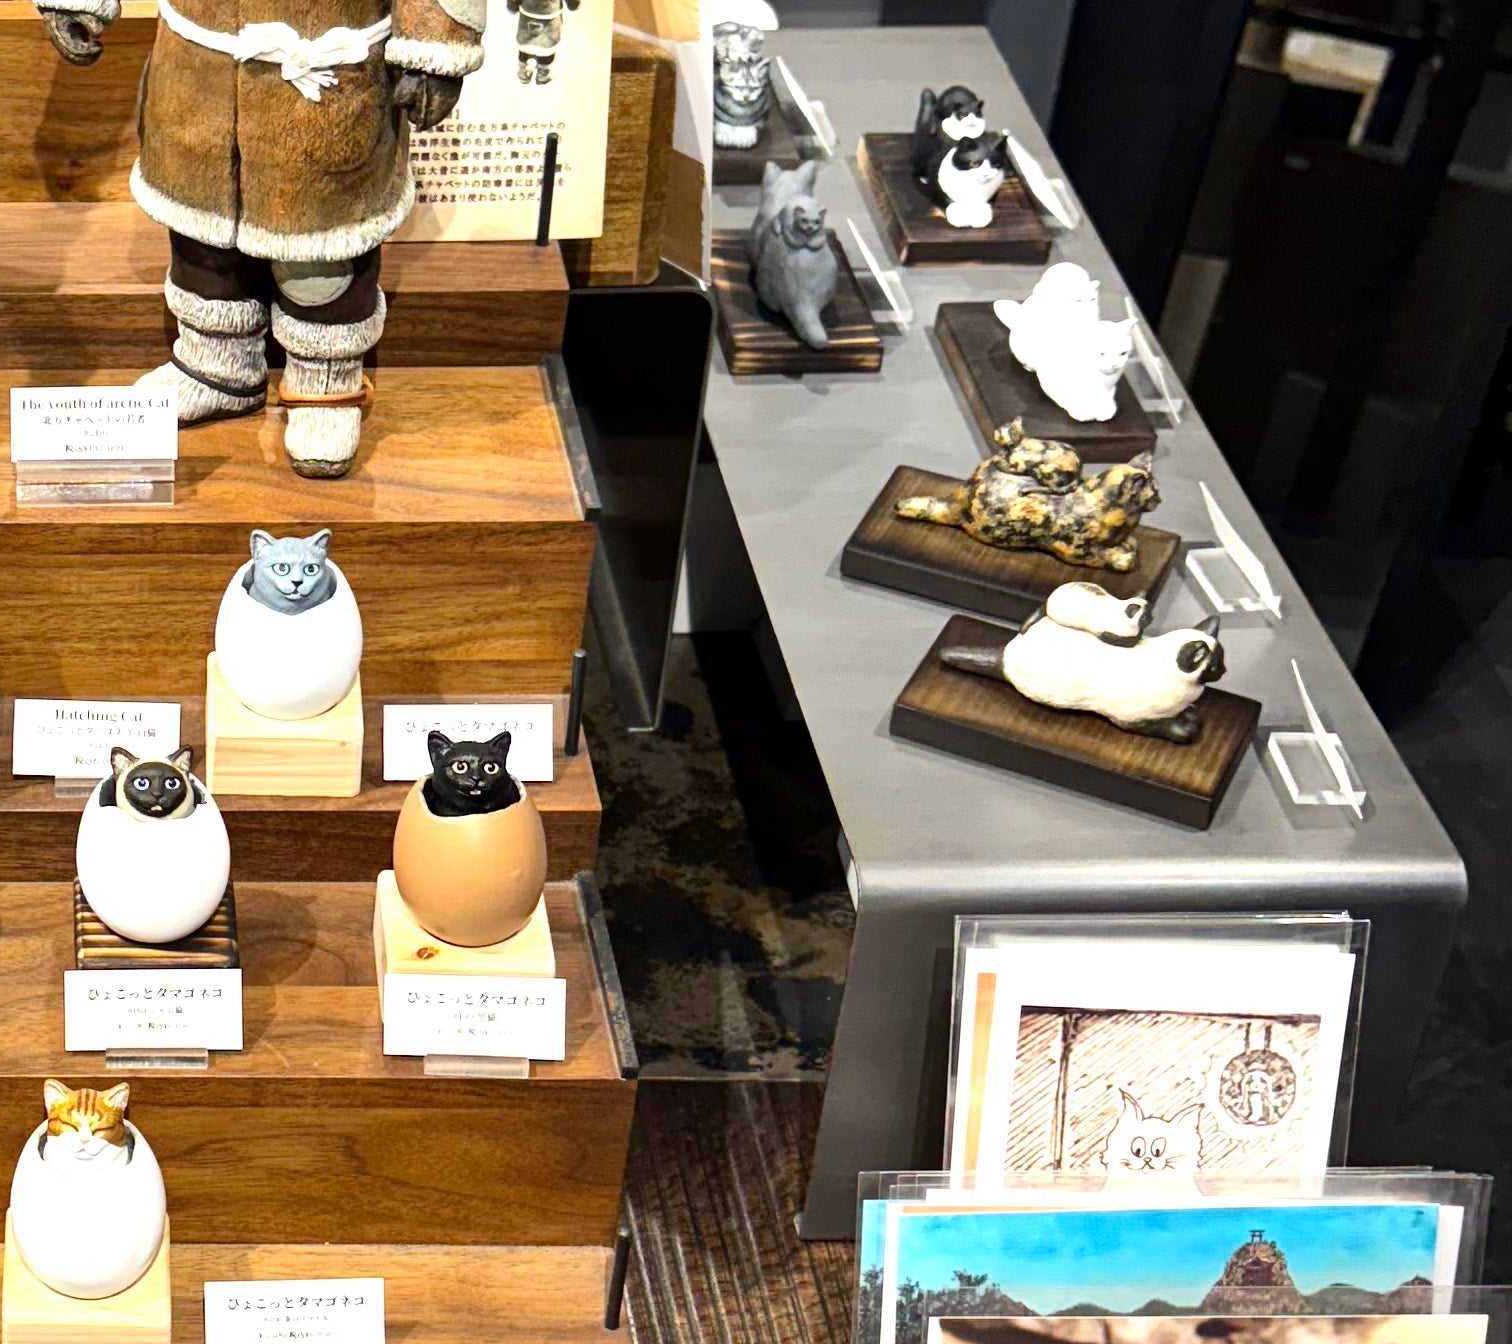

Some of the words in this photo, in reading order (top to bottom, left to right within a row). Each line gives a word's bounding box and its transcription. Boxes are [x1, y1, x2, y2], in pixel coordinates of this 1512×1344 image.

[87, 987, 222, 1000] ひょこっとタマゴネコ
[407, 992, 546, 1006] ひょこっとタマゴネコ
[227, 1296, 365, 1310] ひょこっとタマゴネコ
